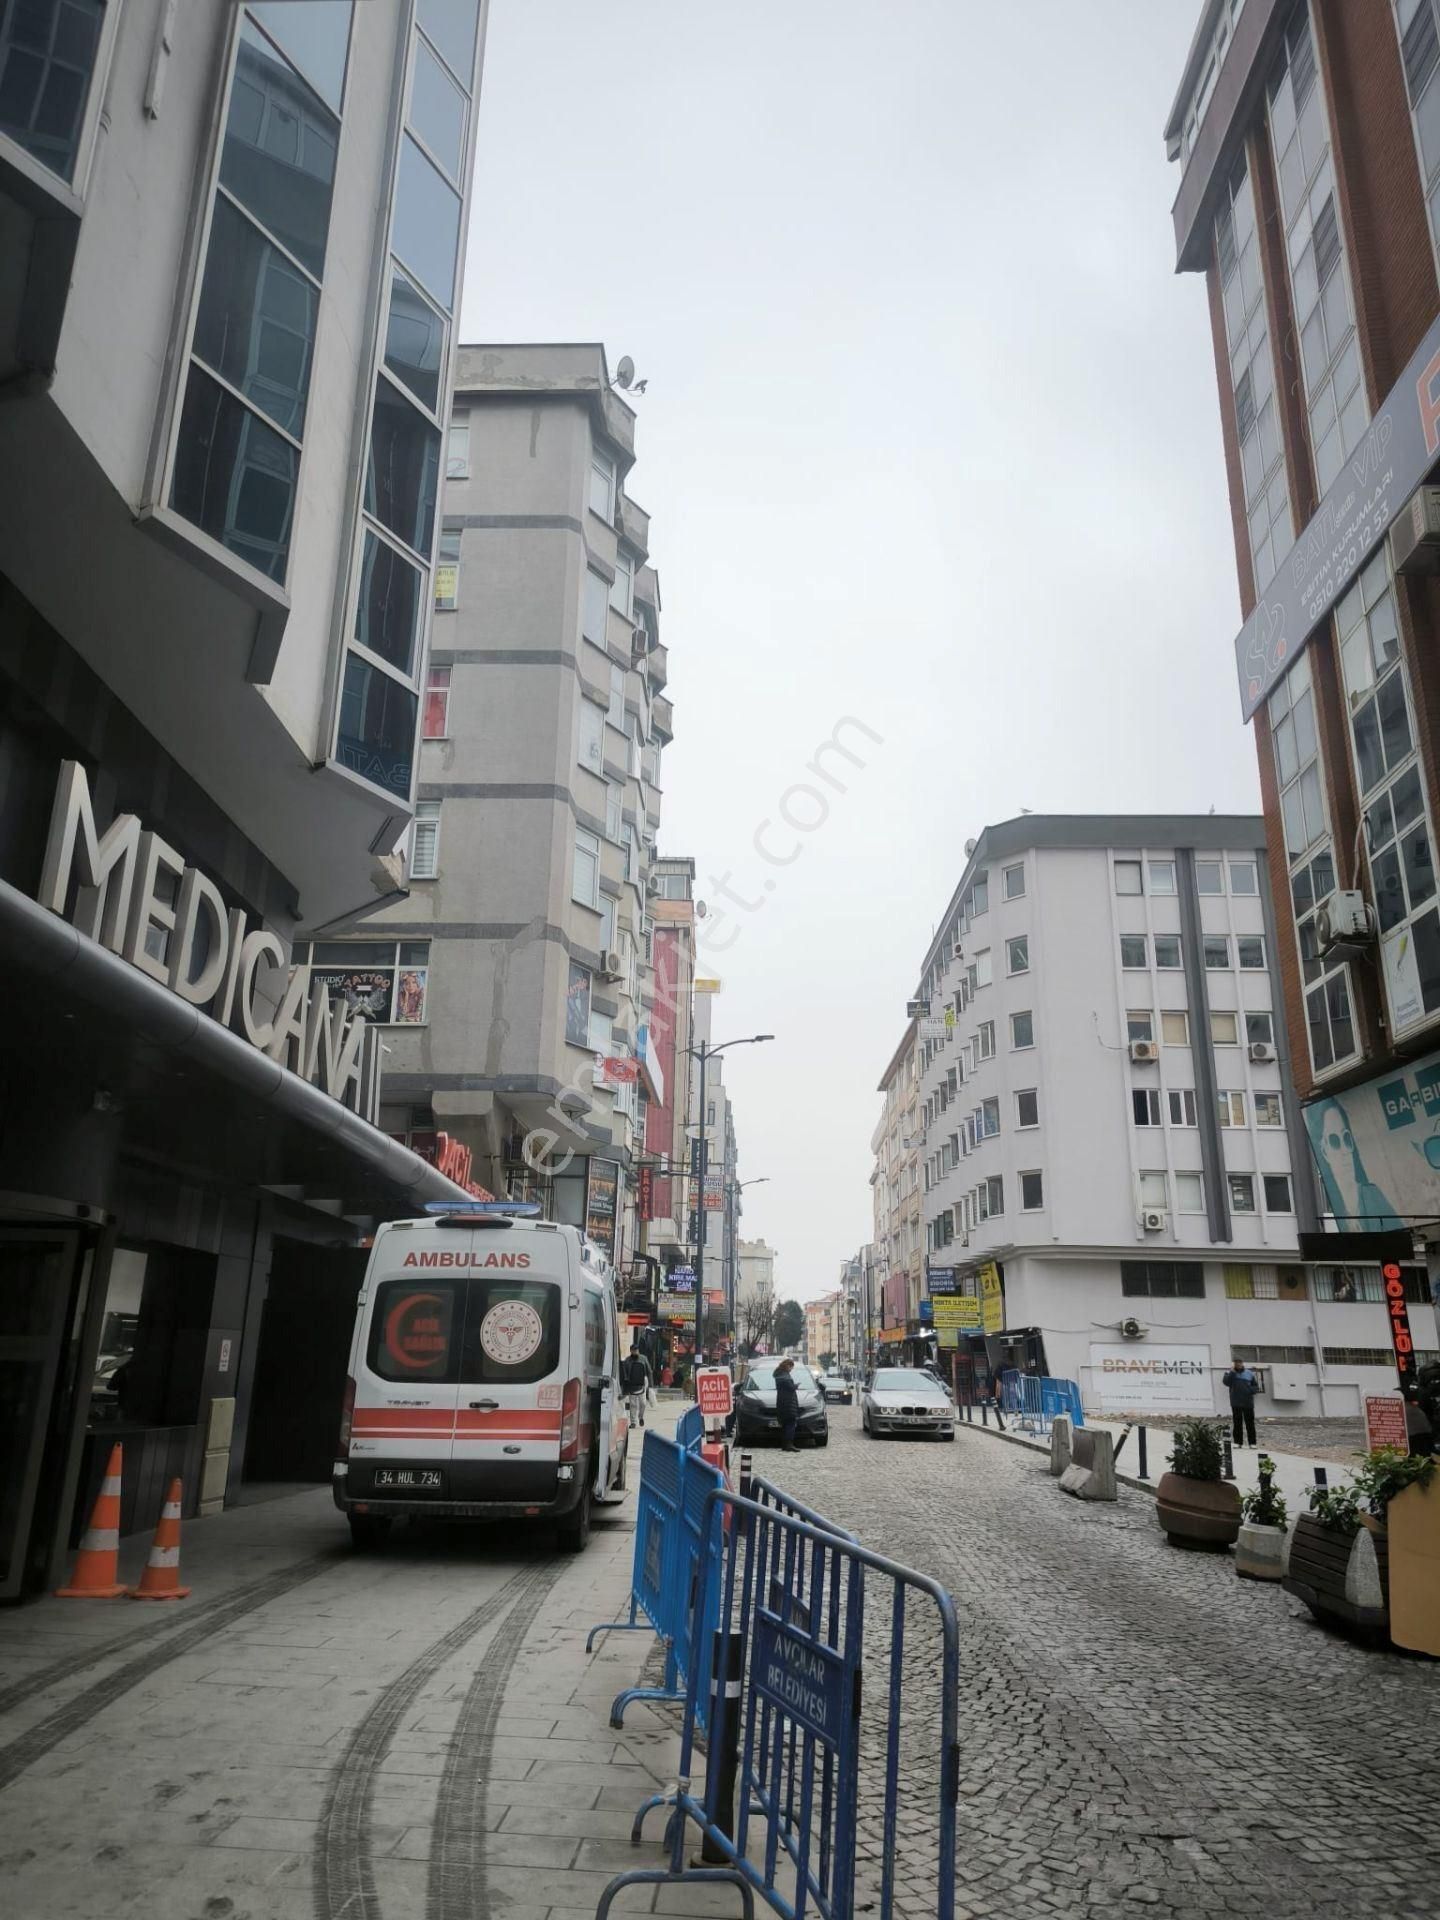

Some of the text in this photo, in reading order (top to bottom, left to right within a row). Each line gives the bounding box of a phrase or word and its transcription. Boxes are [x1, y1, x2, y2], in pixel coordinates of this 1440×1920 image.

[1332, 467, 1394, 562] KURUMLARI
[1310, 579, 1333, 620] 0510
[1335, 546, 1357, 586] 220
[1358, 526, 1372, 552] 12
[1373, 501, 1390, 533] 53
[40, 758, 368, 1116] MEDICANA
[403, 1251, 531, 1269] AMBULANS
[702, 1376, 728, 1392] ACİL
[1102, 1358, 1203, 1376] BRAVEMEN
[381, 1471, 440, 1485] 34 HUL 734
[767, 1663, 827, 1727] BELEDİYESİ
